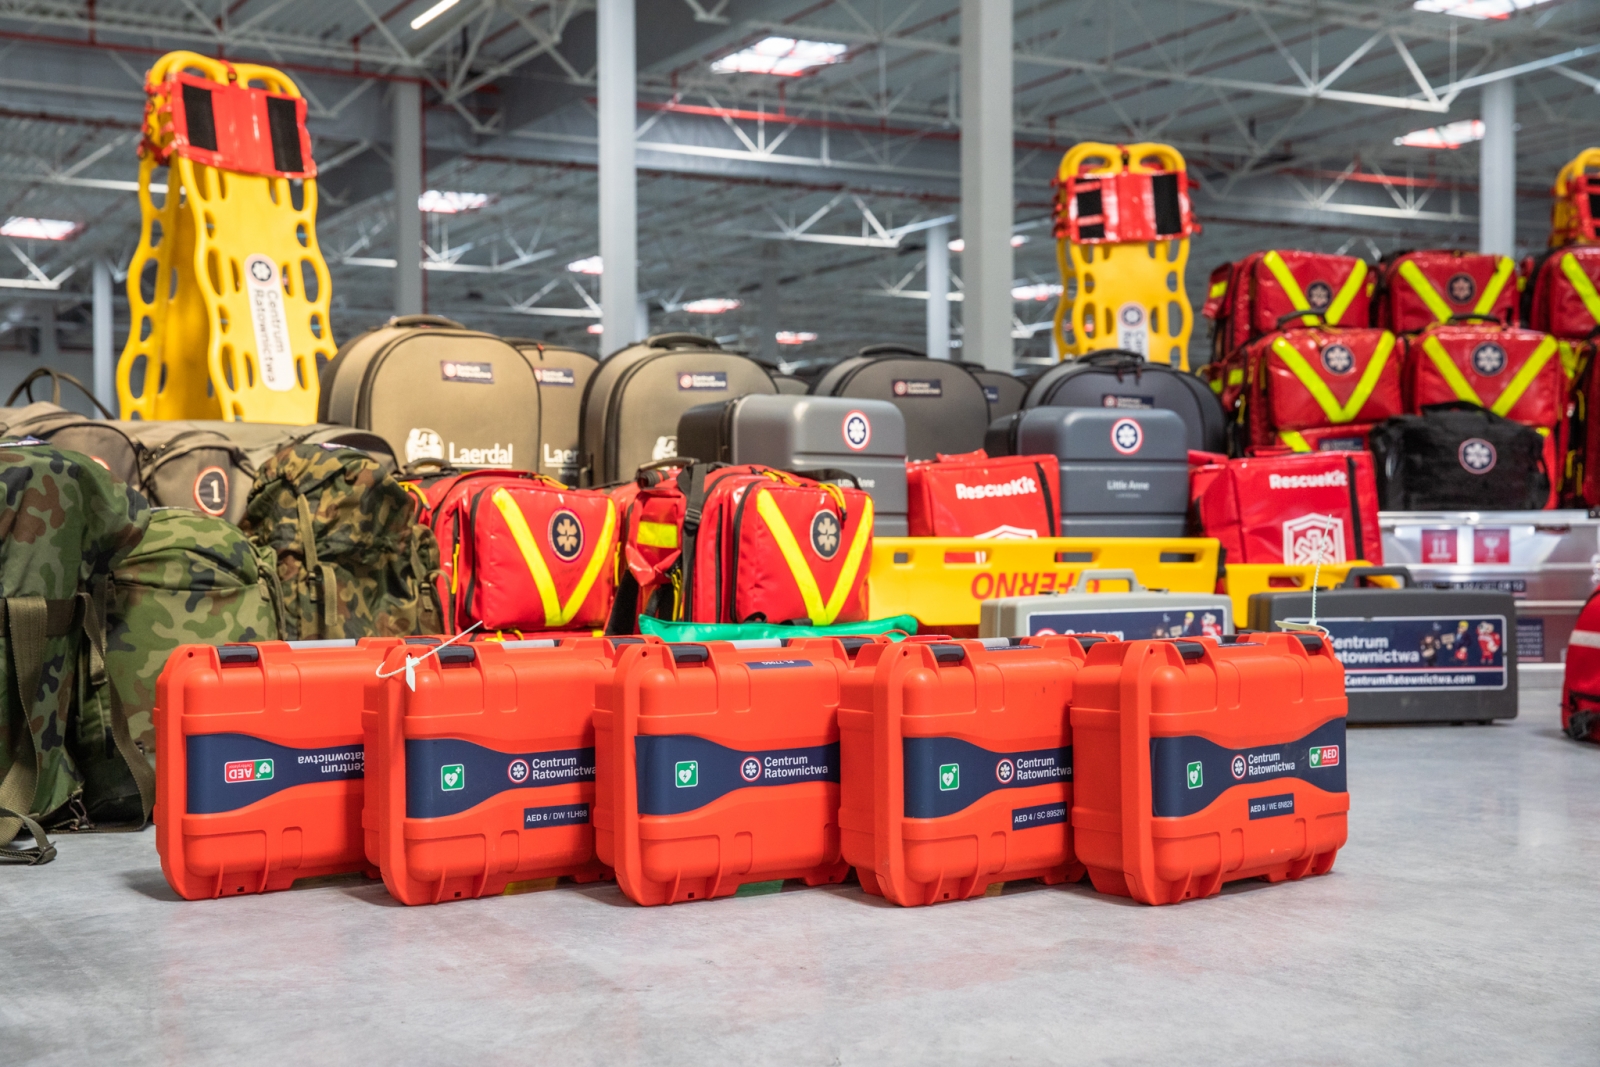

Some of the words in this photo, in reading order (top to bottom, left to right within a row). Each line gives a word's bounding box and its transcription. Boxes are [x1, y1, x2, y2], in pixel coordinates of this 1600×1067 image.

[449, 441, 513, 464] Laerdal
[544, 443, 580, 463] Laer
[1269, 469, 1347, 489] RescueKit
[210, 479, 221, 503] 1
[955, 475, 1038, 500] RescueKit
[1334, 650, 1420, 664] atownictwa
[1248, 752, 1281, 765] Centrum
[1322, 748, 1337, 759] AED
[532, 757, 577, 769] Centrum
[764, 755, 808, 767] Centrum
[1016, 757, 1055, 769] Centrum
[228, 767, 253, 779] AED
[532, 766, 596, 780] Ratownictwa
[764, 764, 828, 778] Ratownictwa
[1016, 766, 1072, 781] Ratownictwa
[1248, 761, 1296, 776] Ratownictwa
[1250, 805, 1261, 813] AED
[1268, 802, 1278, 810] WE
[526, 814, 542, 822] AED
[543, 813, 548, 821] 6
[553, 811, 565, 820] DW
[567, 810, 588, 818] 1LH98
[1014, 815, 1028, 823] AED
[1028, 813, 1033, 821] 4
[1037, 811, 1045, 820] SC
[1046, 808, 1066, 818] 8952W
